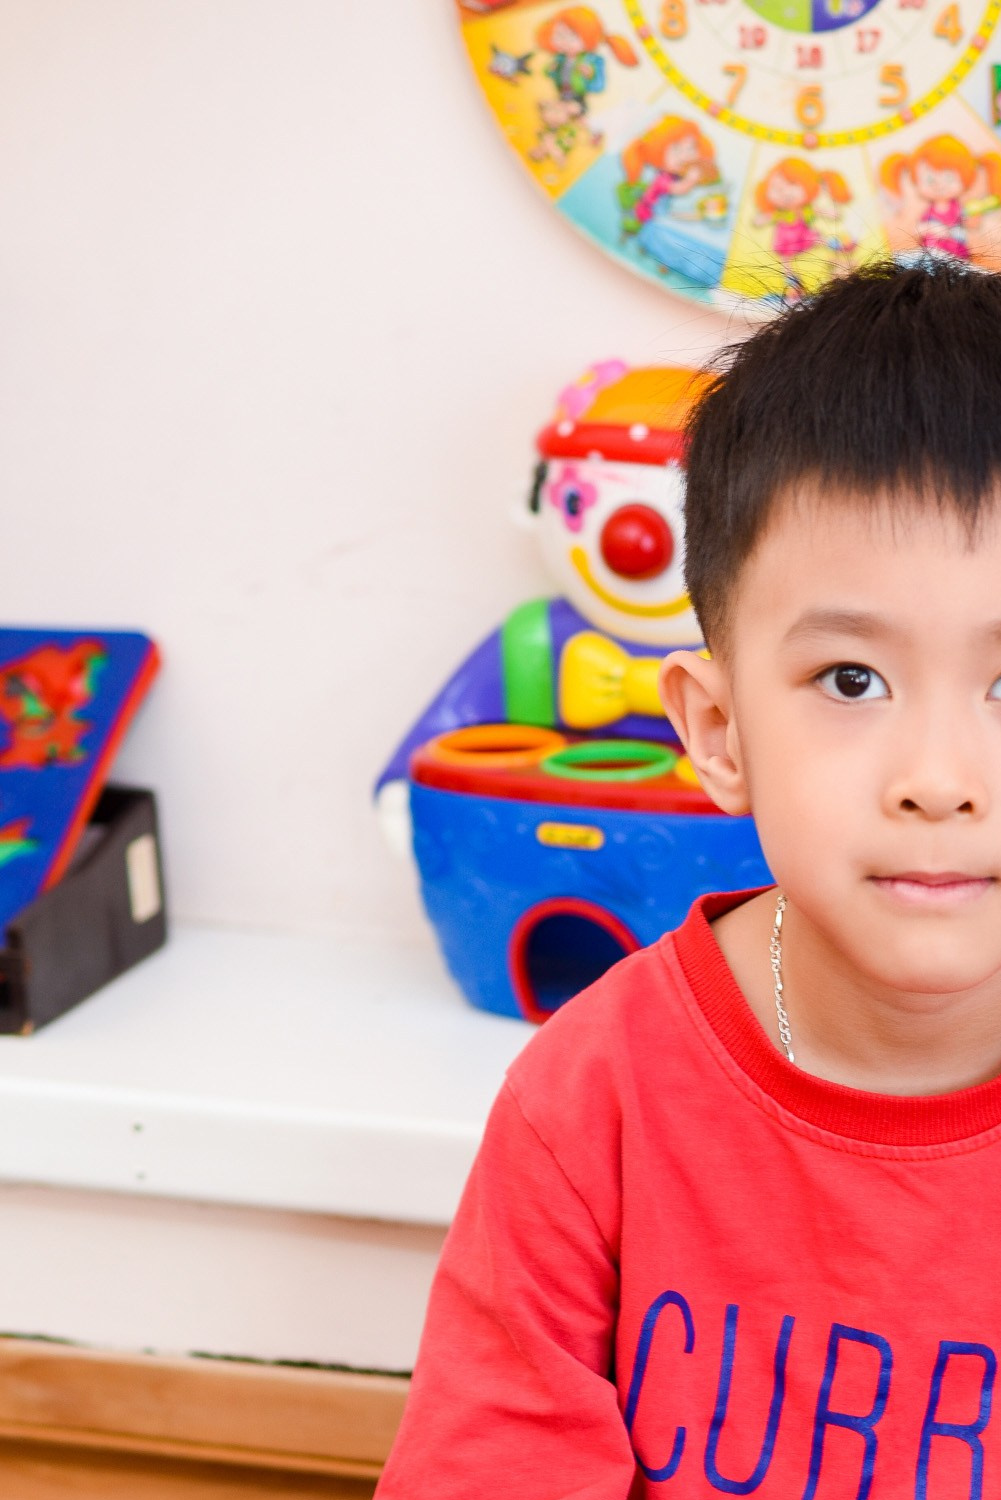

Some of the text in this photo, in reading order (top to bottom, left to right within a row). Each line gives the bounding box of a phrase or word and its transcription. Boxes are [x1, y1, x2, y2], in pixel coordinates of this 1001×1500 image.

[660, 0, 687, 38] 8
[739, 25, 767, 49] 19
[934, 3, 963, 45] 4
[797, 44, 823, 69] 18
[857, 27, 881, 53] 17
[722, 64, 748, 104] 7
[879, 64, 909, 107] 5
[795, 85, 826, 128] 6
